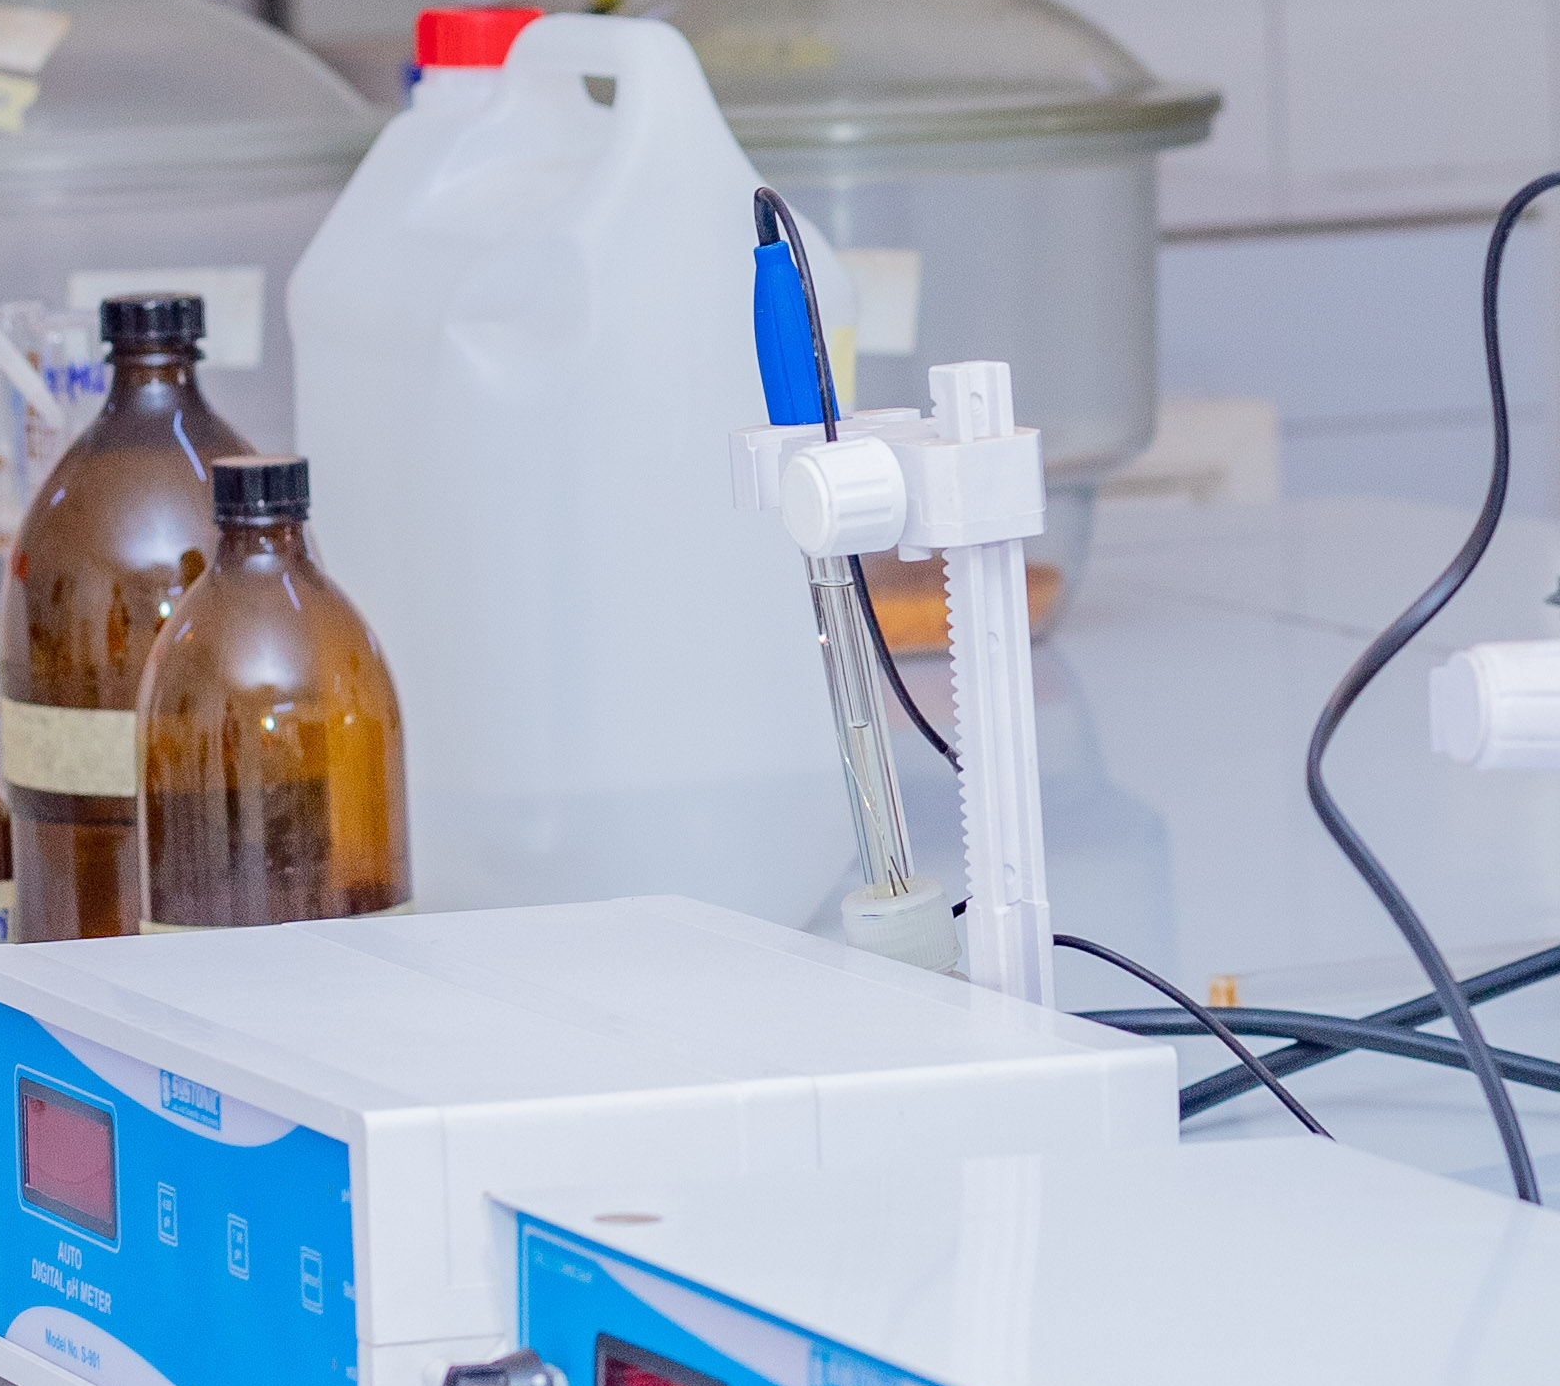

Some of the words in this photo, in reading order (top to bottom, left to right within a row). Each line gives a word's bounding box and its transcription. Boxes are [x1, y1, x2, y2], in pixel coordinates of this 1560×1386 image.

[57, 1239, 83, 1271] AUTO
[31, 1257, 66, 1294] DIGITAL
[65, 1276, 79, 1301] pH
[79, 1280, 112, 1315] METER
[44, 1327, 67, 1356] Model
